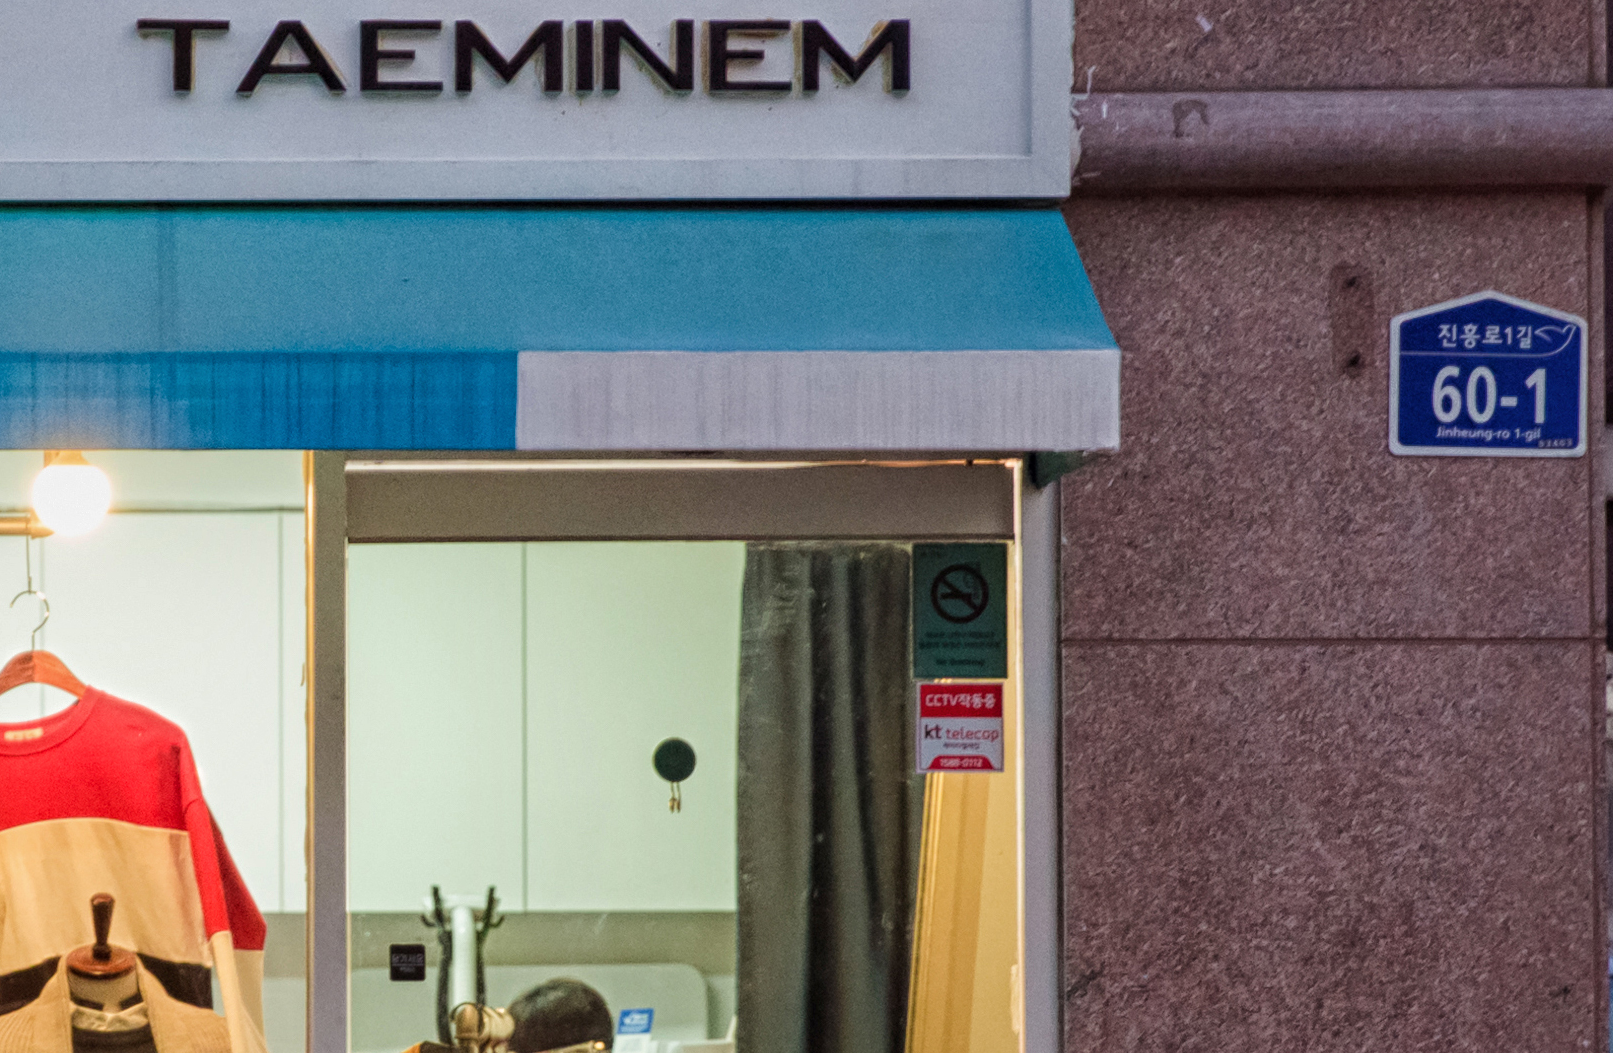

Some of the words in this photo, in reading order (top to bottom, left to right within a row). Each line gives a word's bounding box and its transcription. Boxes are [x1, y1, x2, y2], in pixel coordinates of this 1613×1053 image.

[136, 18, 911, 94] TAEMINEM
[1438, 323, 1533, 349] 진흥로1길
[1432, 365, 1547, 424] 60-1
[1436, 426, 1510, 441] Jinheung-ro
[1514, 427, 1541, 442] 1-gil
[924, 724, 942, 739] kt
[945, 727, 999, 743] telecop
